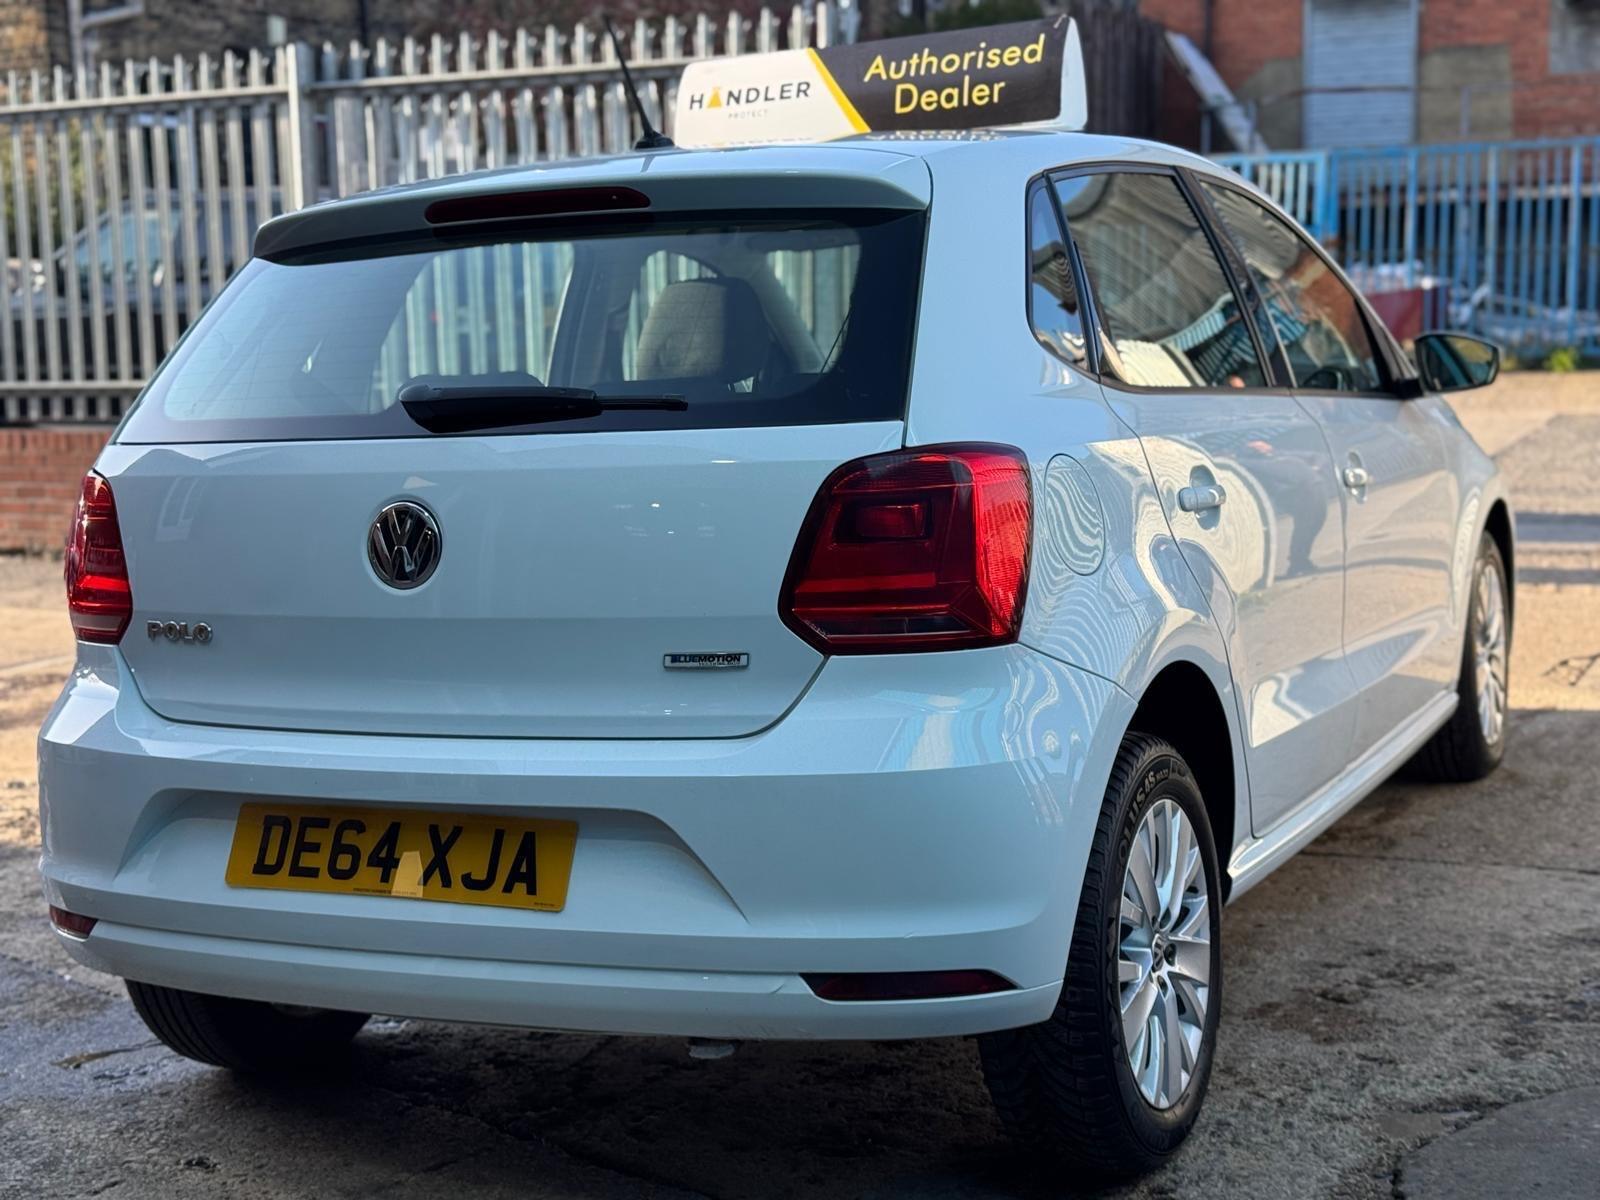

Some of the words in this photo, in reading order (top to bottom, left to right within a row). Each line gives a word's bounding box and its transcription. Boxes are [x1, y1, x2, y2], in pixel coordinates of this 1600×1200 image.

[863, 33, 1047, 83] Authorised
[894, 74, 1006, 115] Dealer
[147, 620, 213, 643] POLO
[252, 814, 401, 884] DE64
[420, 824, 537, 896] XJA
